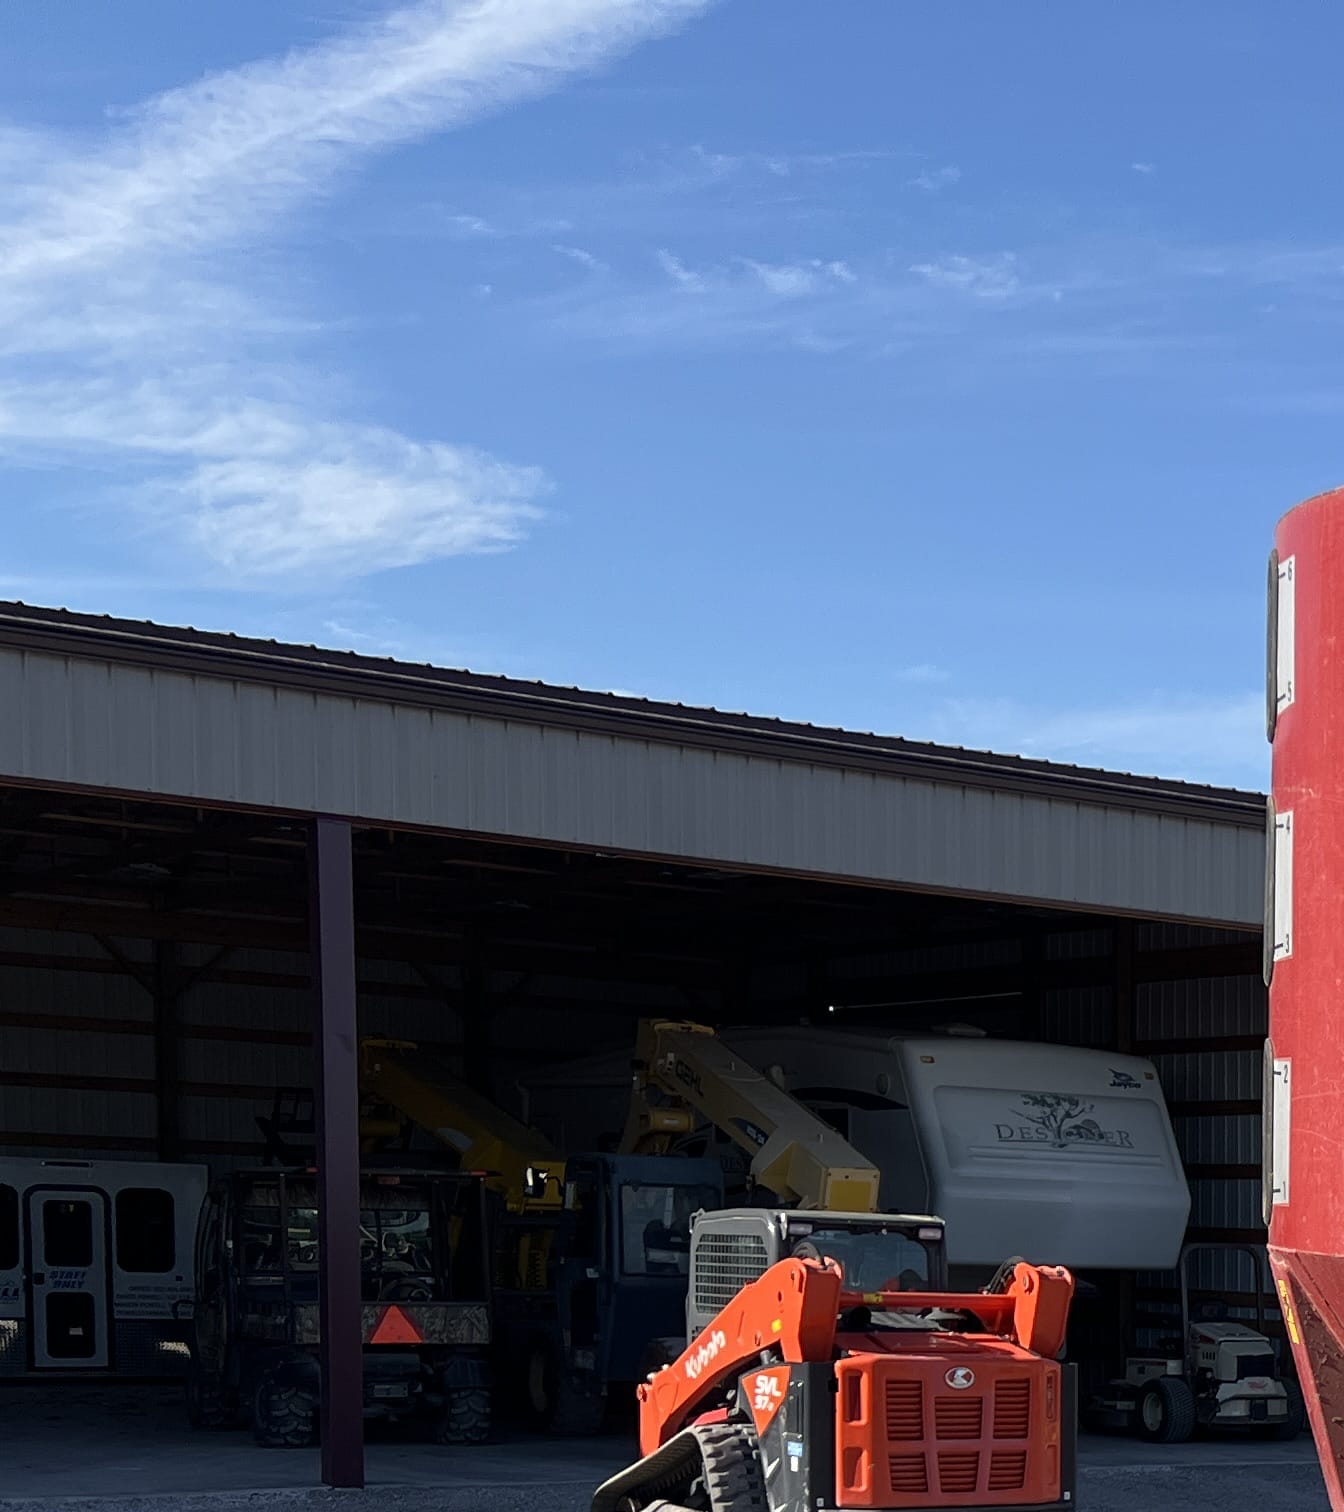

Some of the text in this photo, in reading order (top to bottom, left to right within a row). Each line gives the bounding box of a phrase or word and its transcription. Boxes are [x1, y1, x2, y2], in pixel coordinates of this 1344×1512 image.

[993, 1123, 1135, 1149] DESER
[685, 1330, 726, 1379] Kubota
[755, 1375, 782, 1397] SVL
